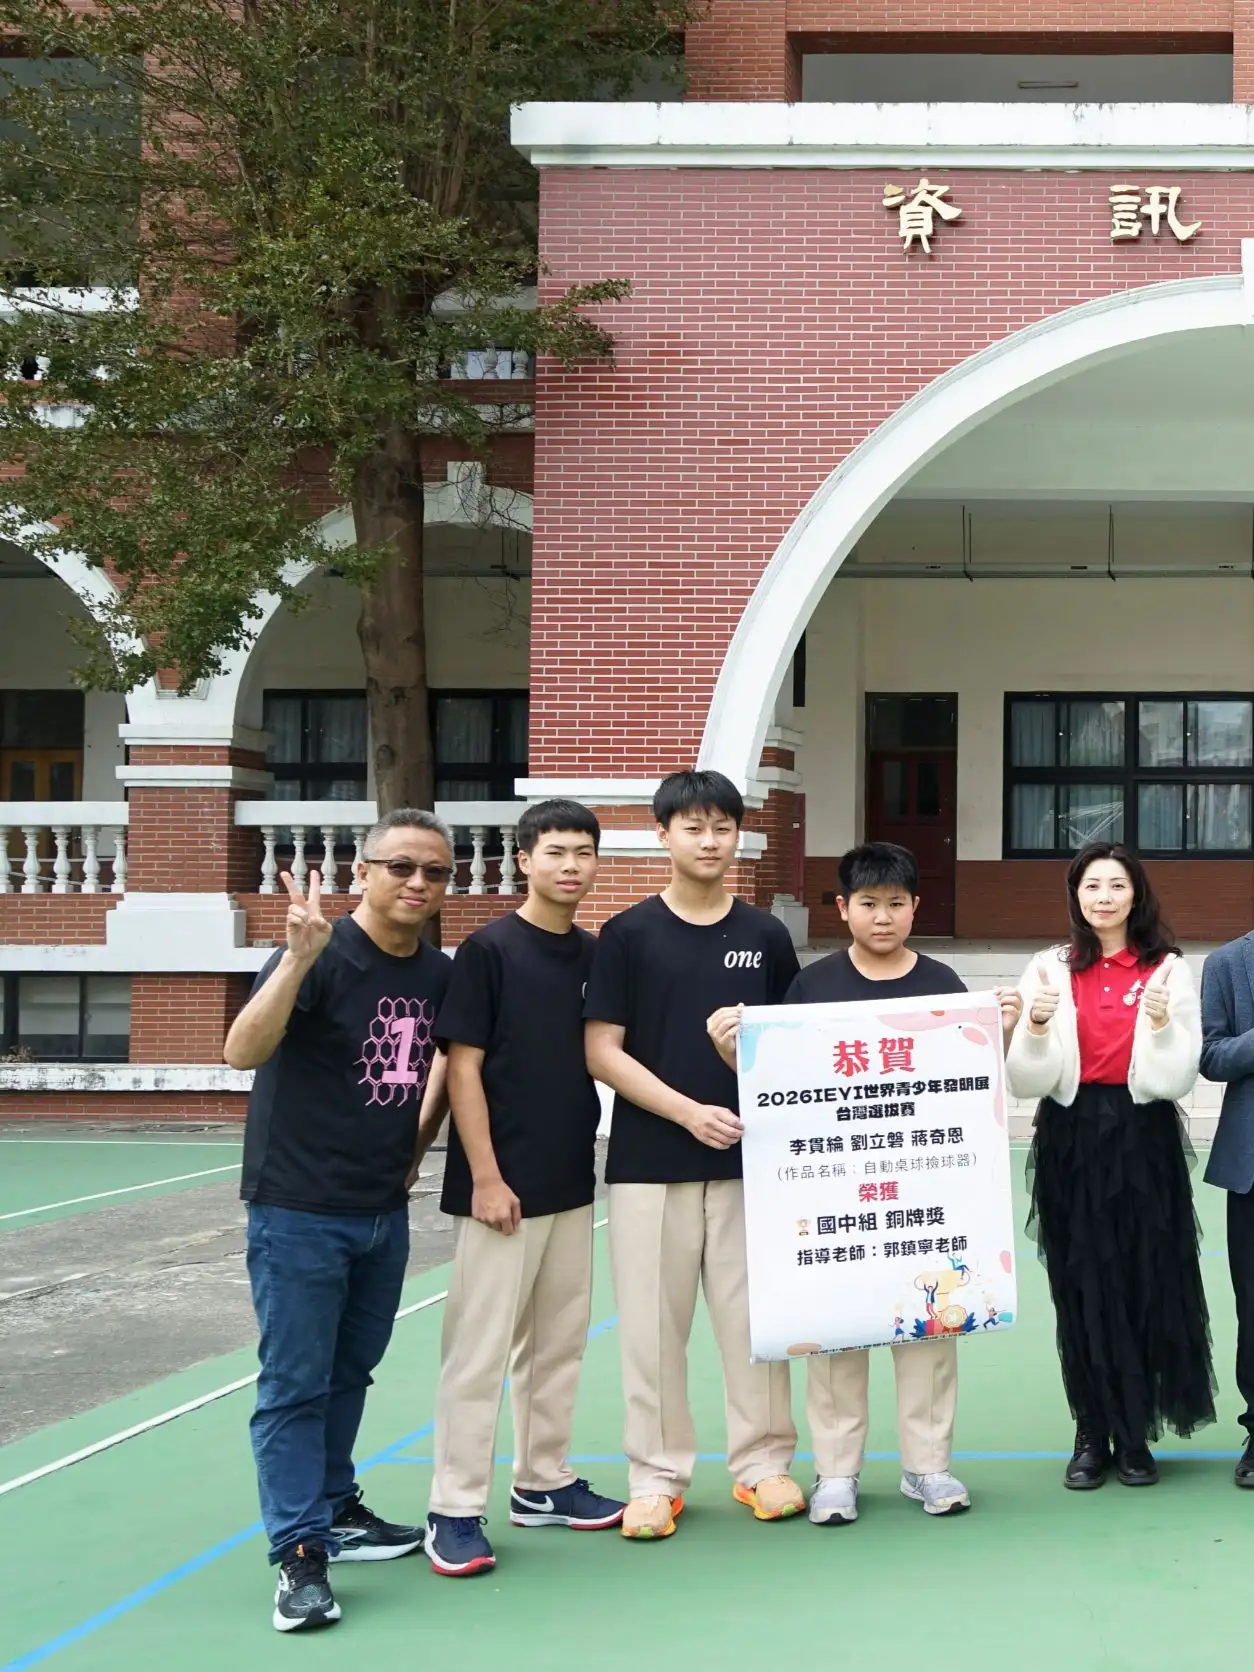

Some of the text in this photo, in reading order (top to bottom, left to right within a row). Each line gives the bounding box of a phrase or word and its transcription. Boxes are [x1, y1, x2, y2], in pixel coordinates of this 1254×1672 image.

[724, 950, 762, 968] one
[381, 1017, 419, 1084] 1
[833, 1037, 917, 1077] 恭賀
[836, 1102, 916, 1122] 台灣選拔賽
[911, 1126, 964, 1147] 蔣奇恩
[858, 1181, 900, 1202] 榮獲
[817, 1206, 946, 1236] 國中組 銅牌獎
